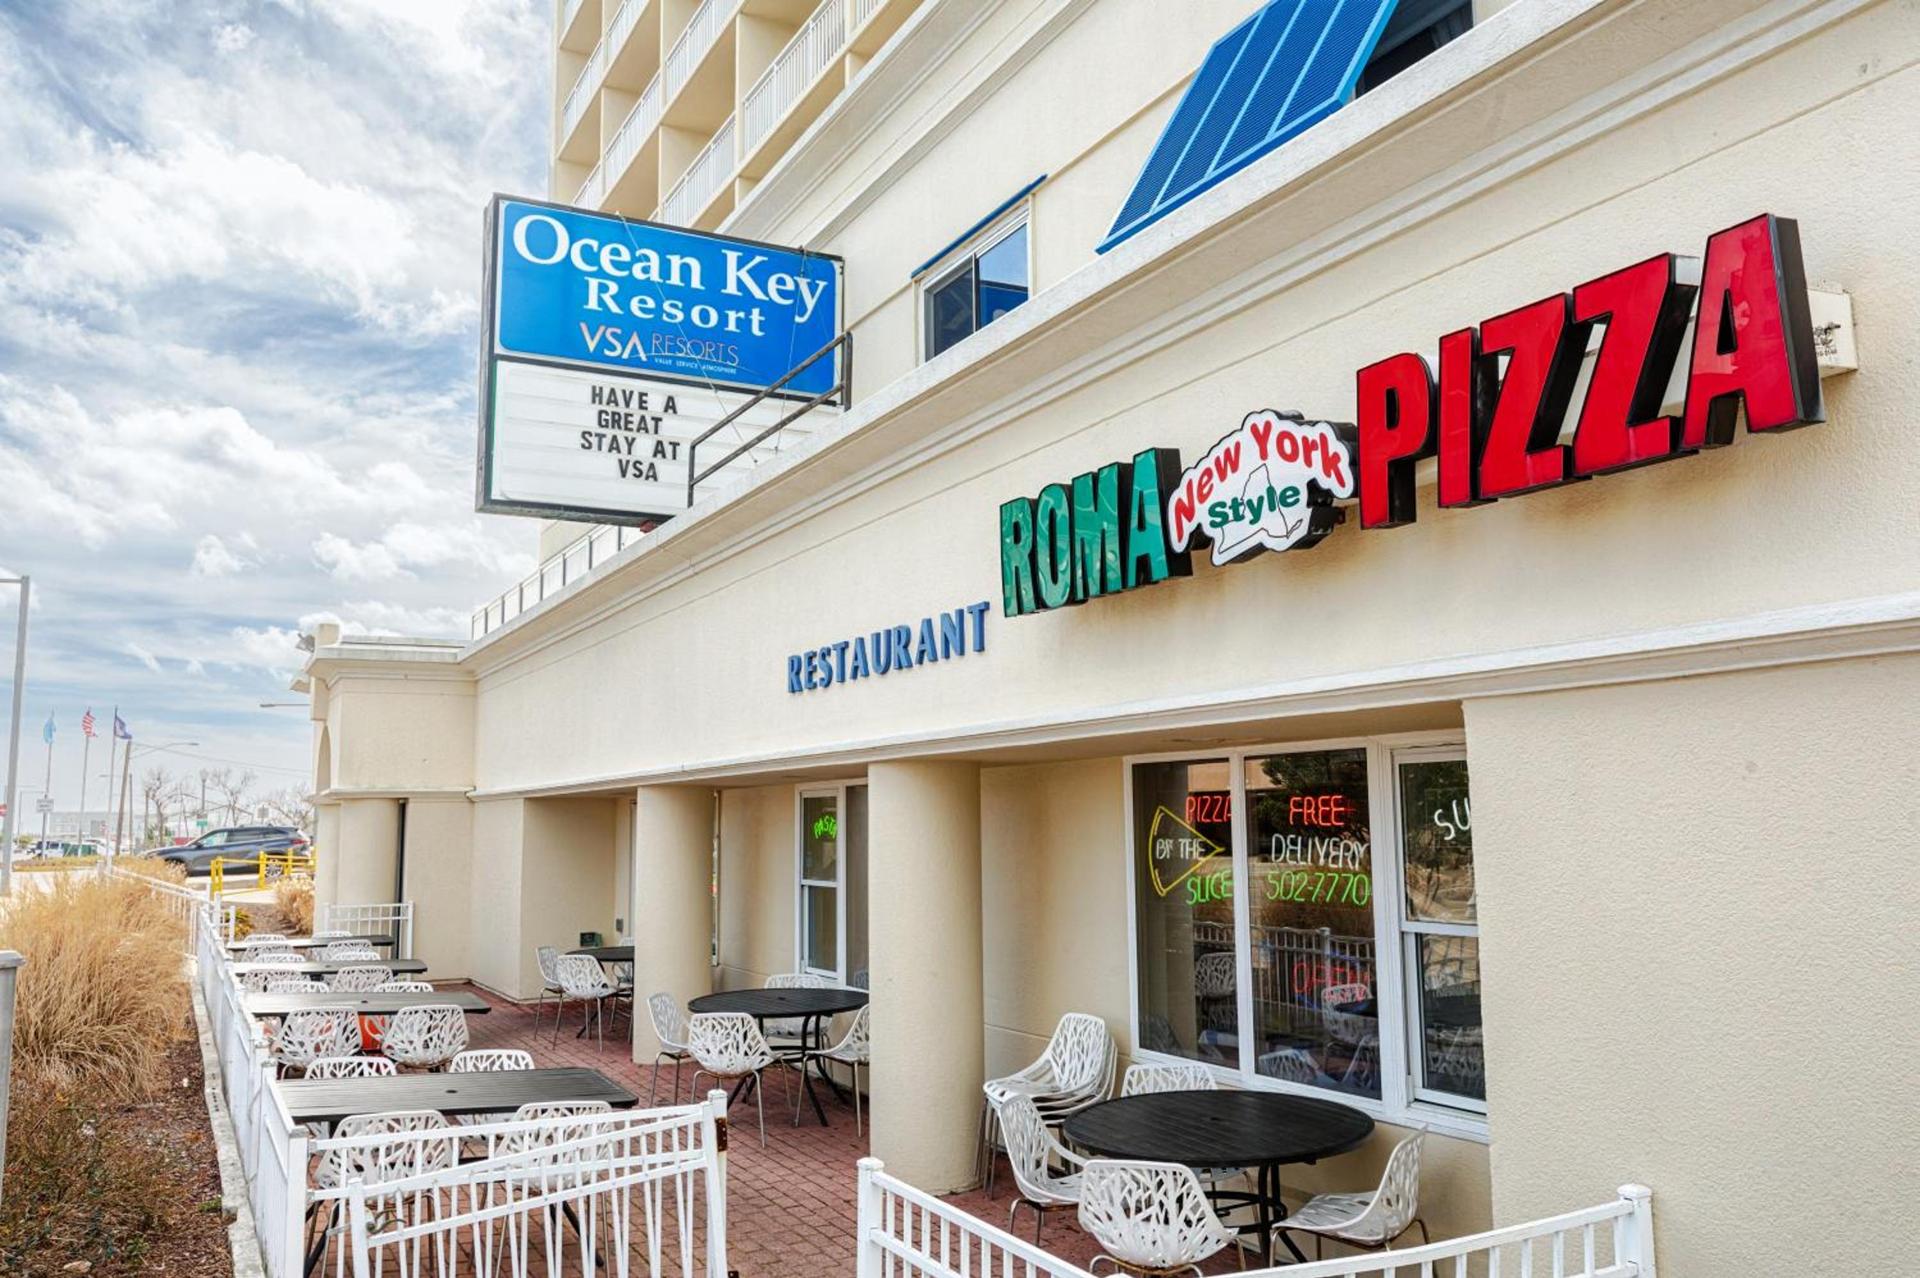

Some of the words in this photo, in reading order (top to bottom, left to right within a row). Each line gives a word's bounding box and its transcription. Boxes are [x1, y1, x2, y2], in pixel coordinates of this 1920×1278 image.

[513, 214, 705, 290] Ocean
[721, 249, 828, 323] Key
[583, 276, 766, 336] Resort
[579, 321, 647, 361] VSA
[651, 332, 739, 366] RESORTS
[1357, 213, 1808, 530] PIZZA
[591, 385, 649, 410] HAVE
[663, 395, 678, 414] A
[597, 409, 663, 435] GREAT
[580, 430, 636, 456] STAY
[652, 439, 680, 460] AT
[617, 458, 658, 482] VSA
[1173, 440, 1241, 543] New
[1250, 420, 1346, 489] York
[1207, 485, 1301, 529] Style
[1000, 448, 1169, 617] ROMA
[787, 600, 990, 693] RESTAURANT
[1289, 795, 1345, 826] FREE
[1178, 838, 1205, 860] THE
[1271, 833, 1369, 871] DELIVERY
[1186, 869, 1233, 905] SLICE
[1266, 870, 1370, 906] 502-7770
